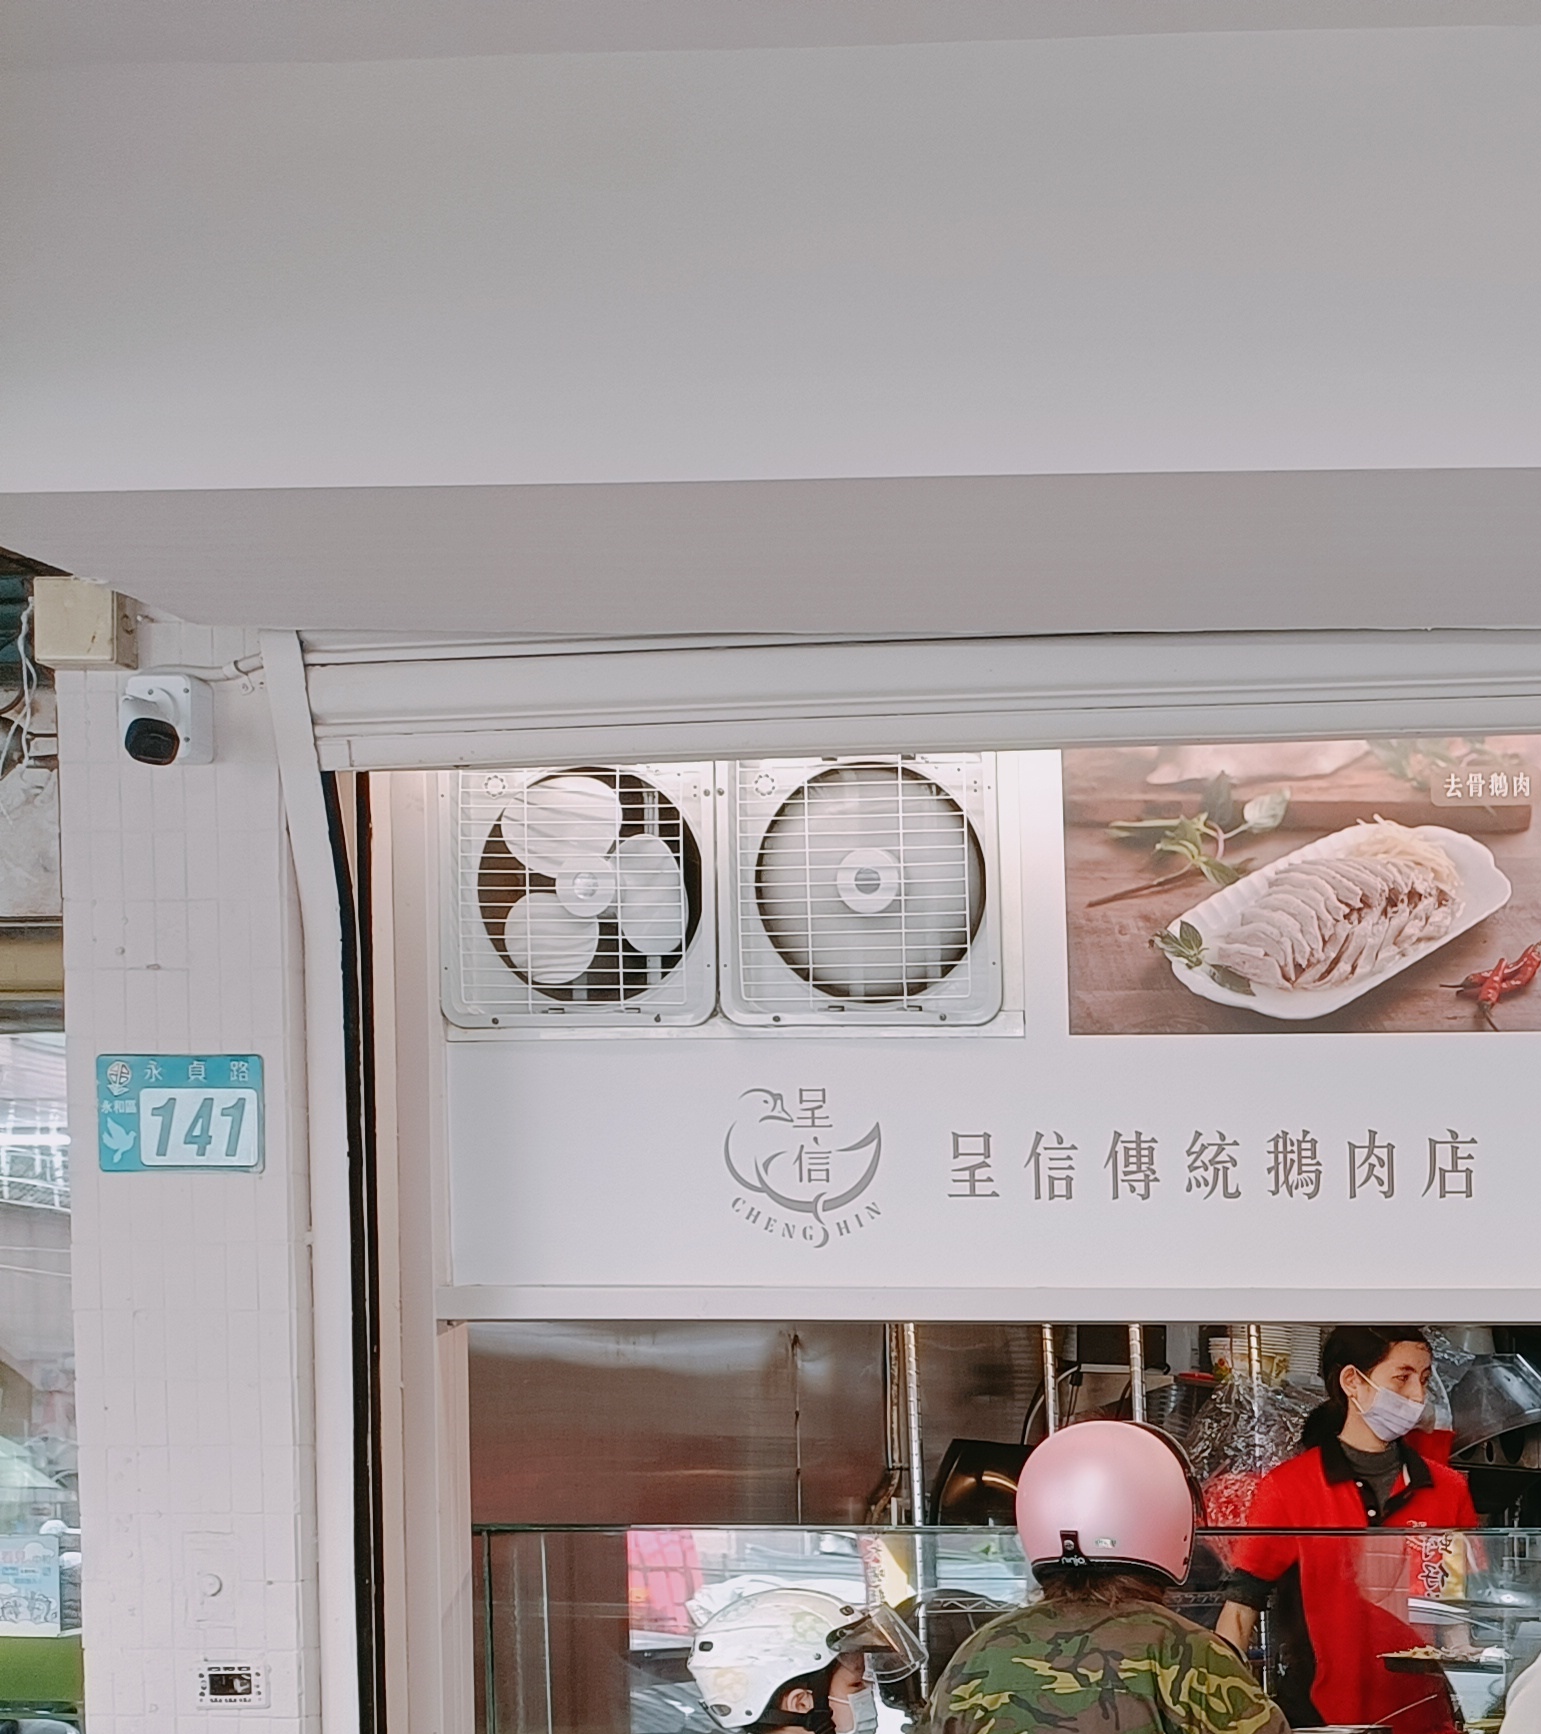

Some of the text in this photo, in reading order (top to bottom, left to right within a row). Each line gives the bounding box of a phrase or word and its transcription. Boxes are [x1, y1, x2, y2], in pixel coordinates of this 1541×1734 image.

[1443, 770, 1532, 799] 去骨鵝肉
[144, 1060, 249, 1082] 永貞路
[101, 1101, 136, 1114] 永和區
[151, 1097, 246, 1157] 141
[947, 1128, 1480, 1202] 呈信傳統鵝肉店
